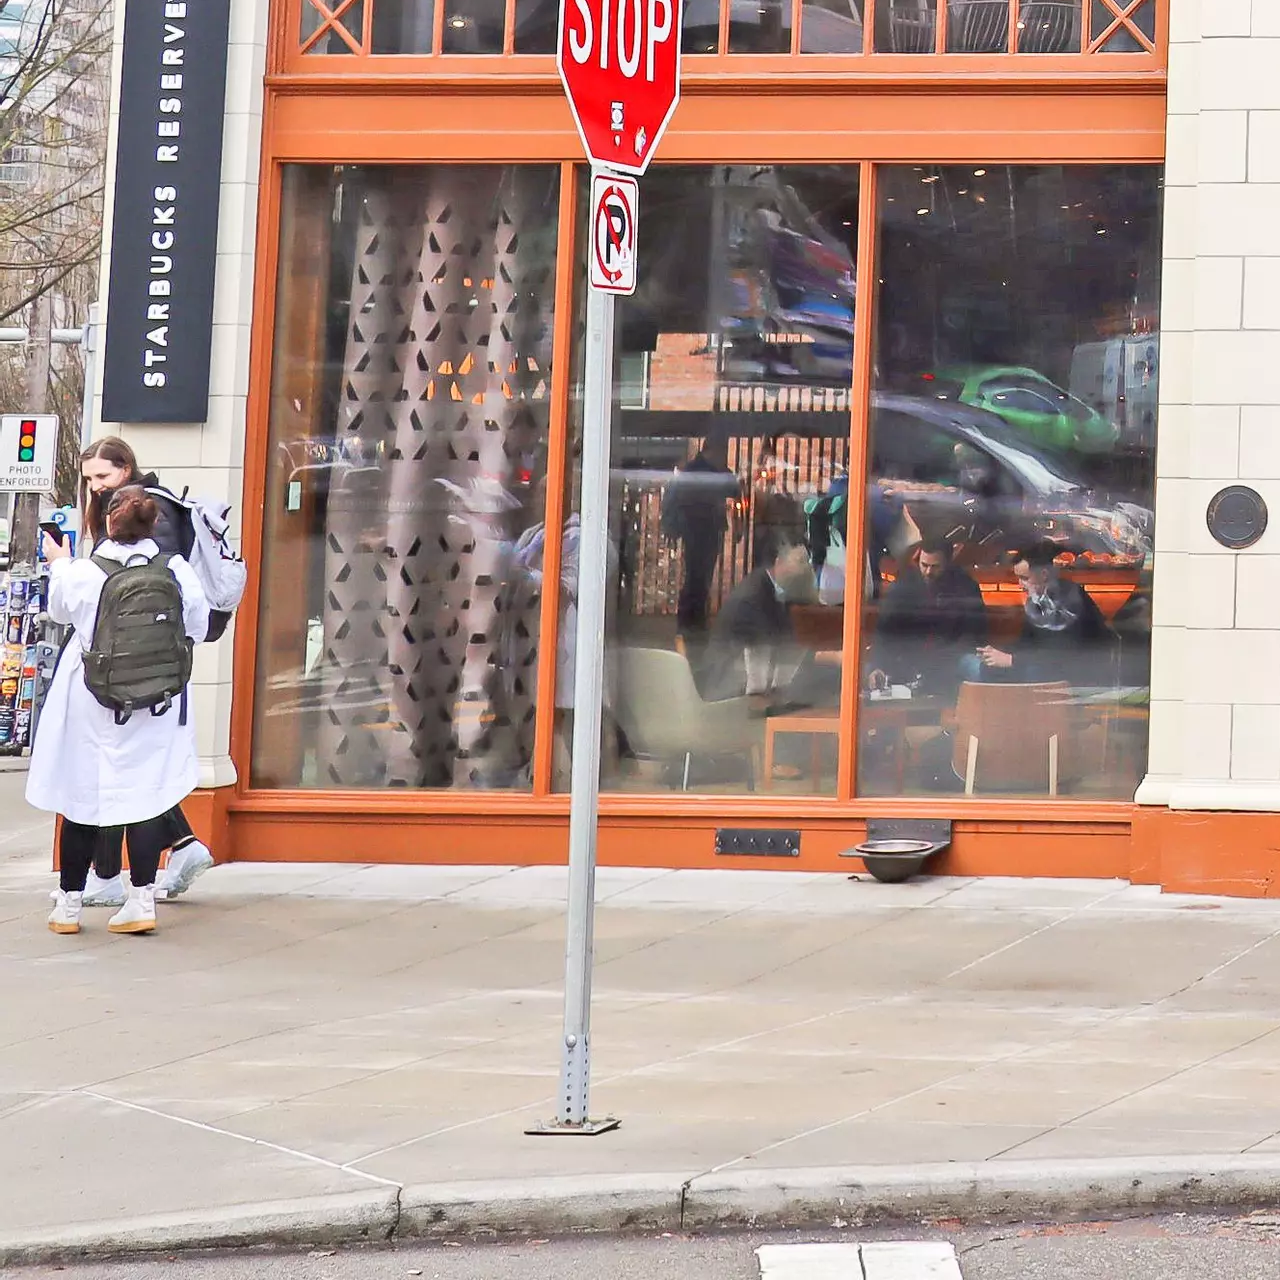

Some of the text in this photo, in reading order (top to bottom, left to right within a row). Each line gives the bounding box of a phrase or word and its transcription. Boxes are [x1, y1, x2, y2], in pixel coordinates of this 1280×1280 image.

[143, 185, 177, 388] STARBUCKS
[9, 465, 42, 475] PHOTO
[0, 477, 50, 486] ENFORCED
